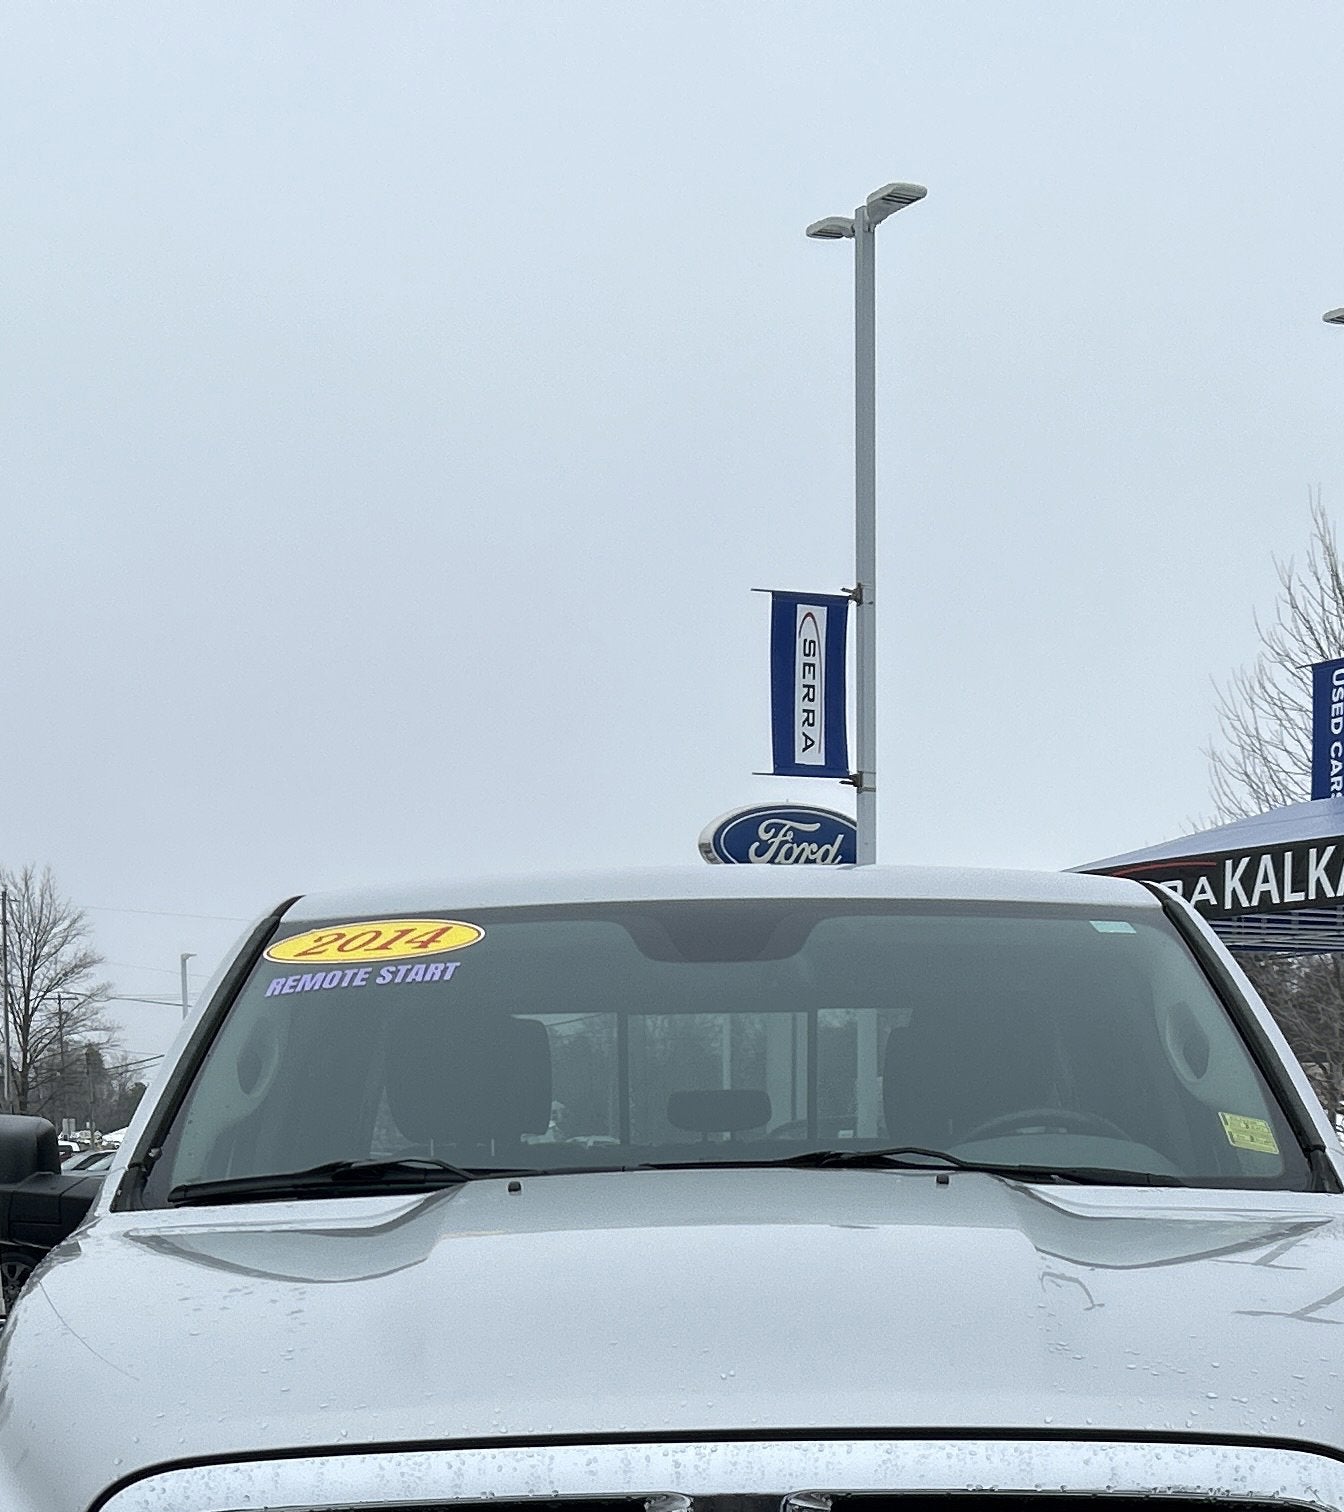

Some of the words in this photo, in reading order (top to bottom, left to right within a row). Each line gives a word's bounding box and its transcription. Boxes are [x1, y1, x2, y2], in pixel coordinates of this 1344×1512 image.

[801, 638, 816, 754] SERRA
[748, 818, 844, 864] Ford
[293, 926, 453, 958] 2014
[264, 967, 372, 998] REMOTE
[375, 962, 461, 985] START
